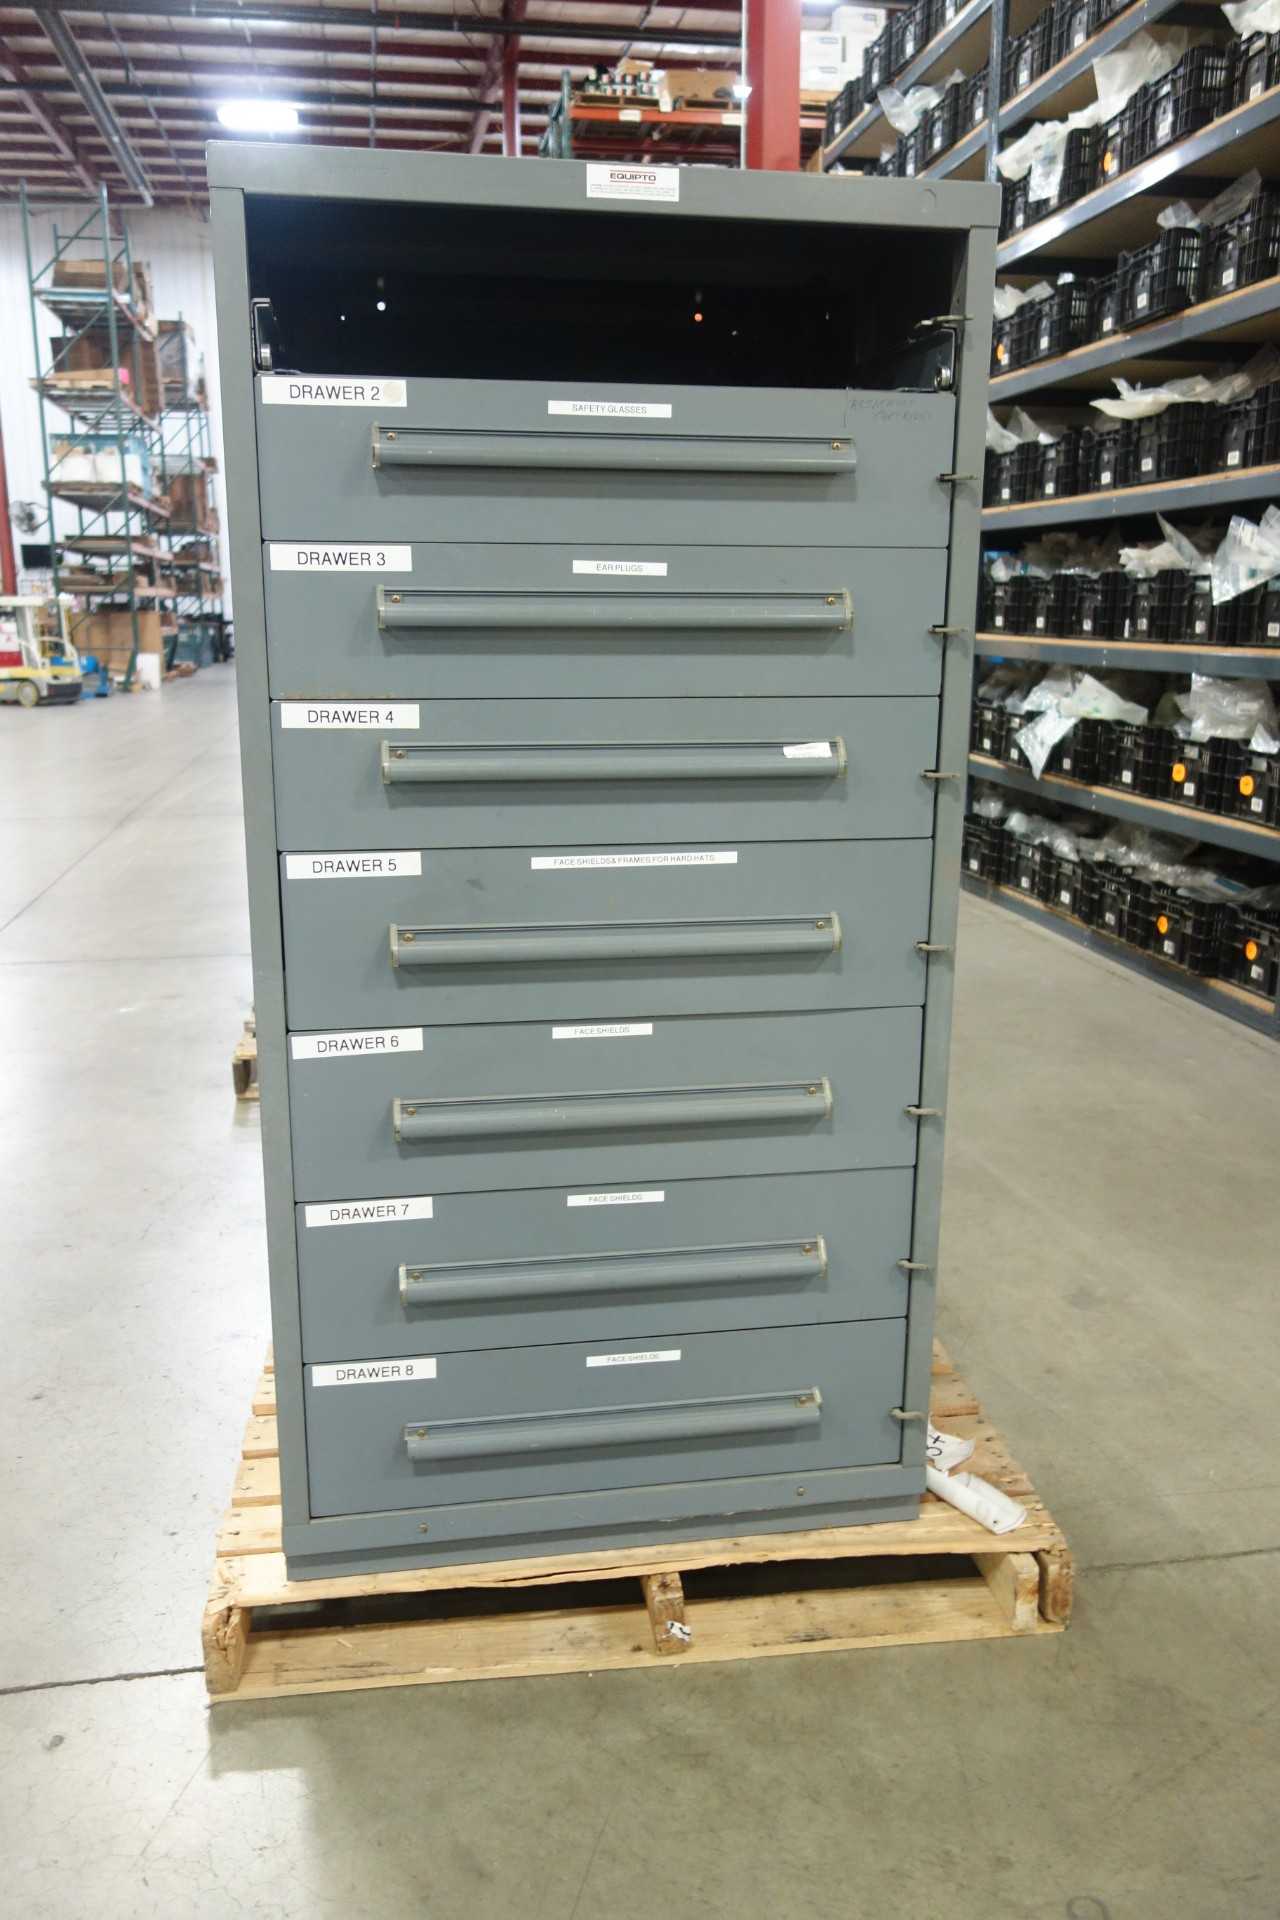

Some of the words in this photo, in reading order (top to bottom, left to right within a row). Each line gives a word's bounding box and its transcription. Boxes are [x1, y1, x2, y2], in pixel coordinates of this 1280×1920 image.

[609, 172, 657, 182] EQUIPTO
[289, 384, 365, 400] DRAWER
[371, 386, 380, 400] 2
[572, 404, 605, 413] SAFETY
[608, 405, 647, 414] GLASSES
[297, 552, 371, 566] DRAWER
[377, 553, 386, 566] 3
[596, 563, 613, 571] EAR
[615, 564, 643, 572] PLUGS
[308, 710, 379, 723] DRAWER
[385, 711, 393, 723] 4
[312, 859, 383, 873] DRAWER
[388, 859, 396, 871] 5
[553, 858, 576, 866] FACE
[618, 856, 651, 864] FRAMES
[652, 855, 669, 863] FOR
[693, 854, 714, 862] HATS
[597, 1026, 630, 1034] SHIELDS
[317, 1036, 385, 1053] DRAWER
[391, 1036, 399, 1048] 6
[609, 1194, 642, 1202] SHIELDS
[330, 1204, 396, 1220] DRAWER
[401, 1204, 409, 1216] 7
[607, 1355, 627, 1363] FACE
[629, 1353, 659, 1361] SHIELDS
[336, 1365, 400, 1381] DRAWER
[406, 1365, 413, 1376] 8
